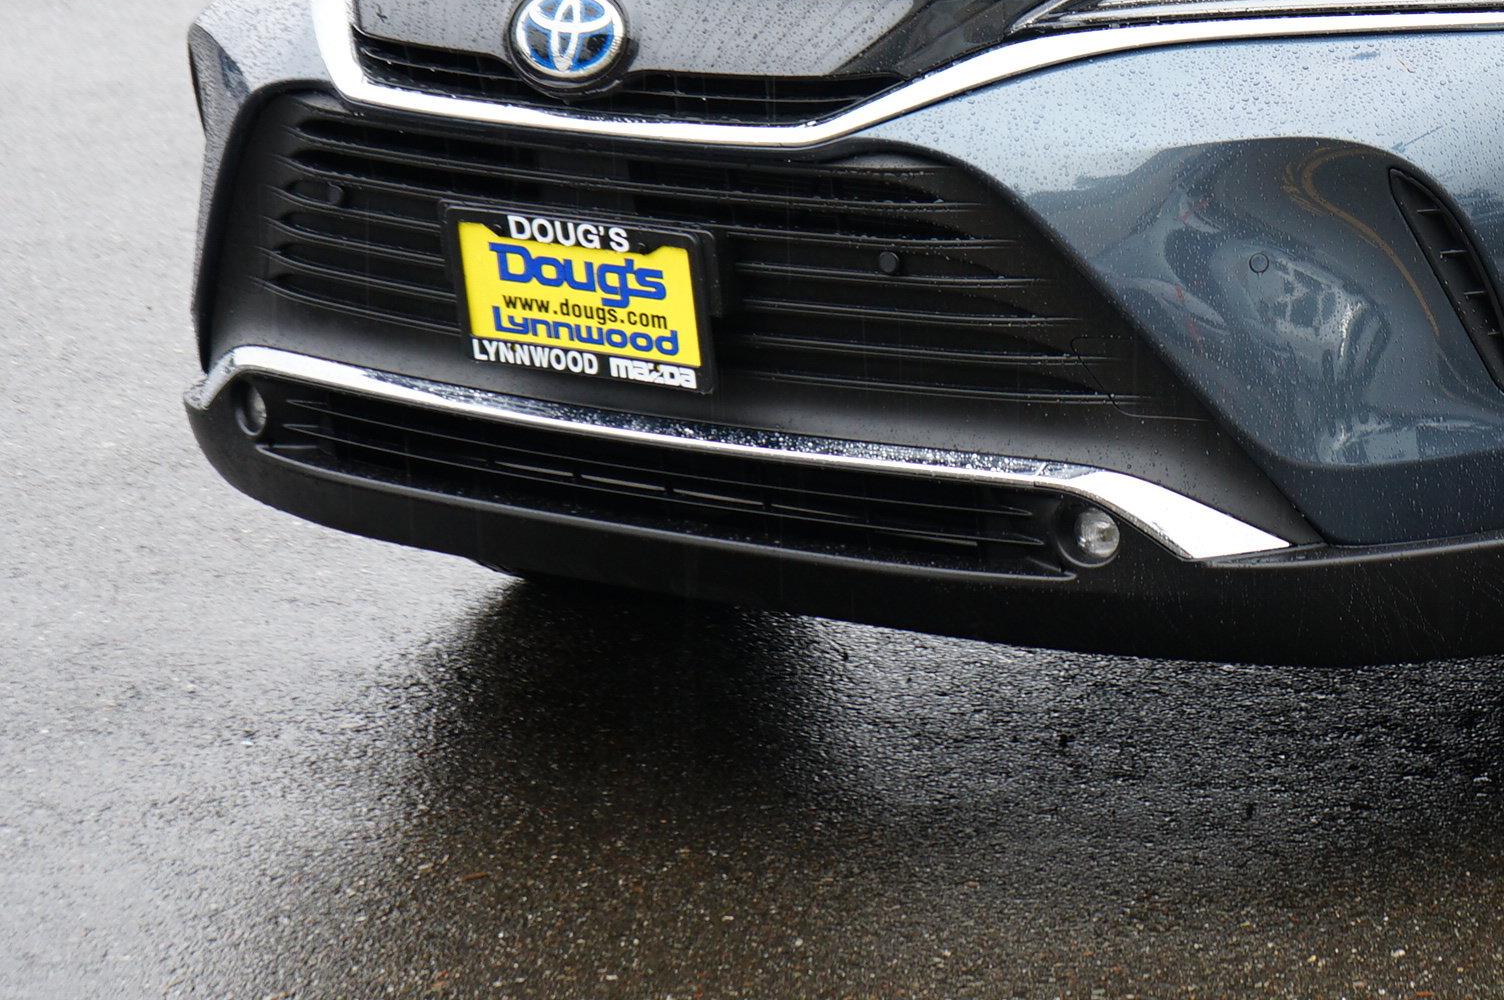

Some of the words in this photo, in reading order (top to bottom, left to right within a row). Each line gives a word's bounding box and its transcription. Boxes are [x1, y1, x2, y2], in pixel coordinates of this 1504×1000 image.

[507, 215, 630, 253] DOUG'S
[492, 306, 679, 355] Lynnwood
[502, 295, 668, 329] www.dougs.com
[472, 339, 599, 375] LYNNWOOD
